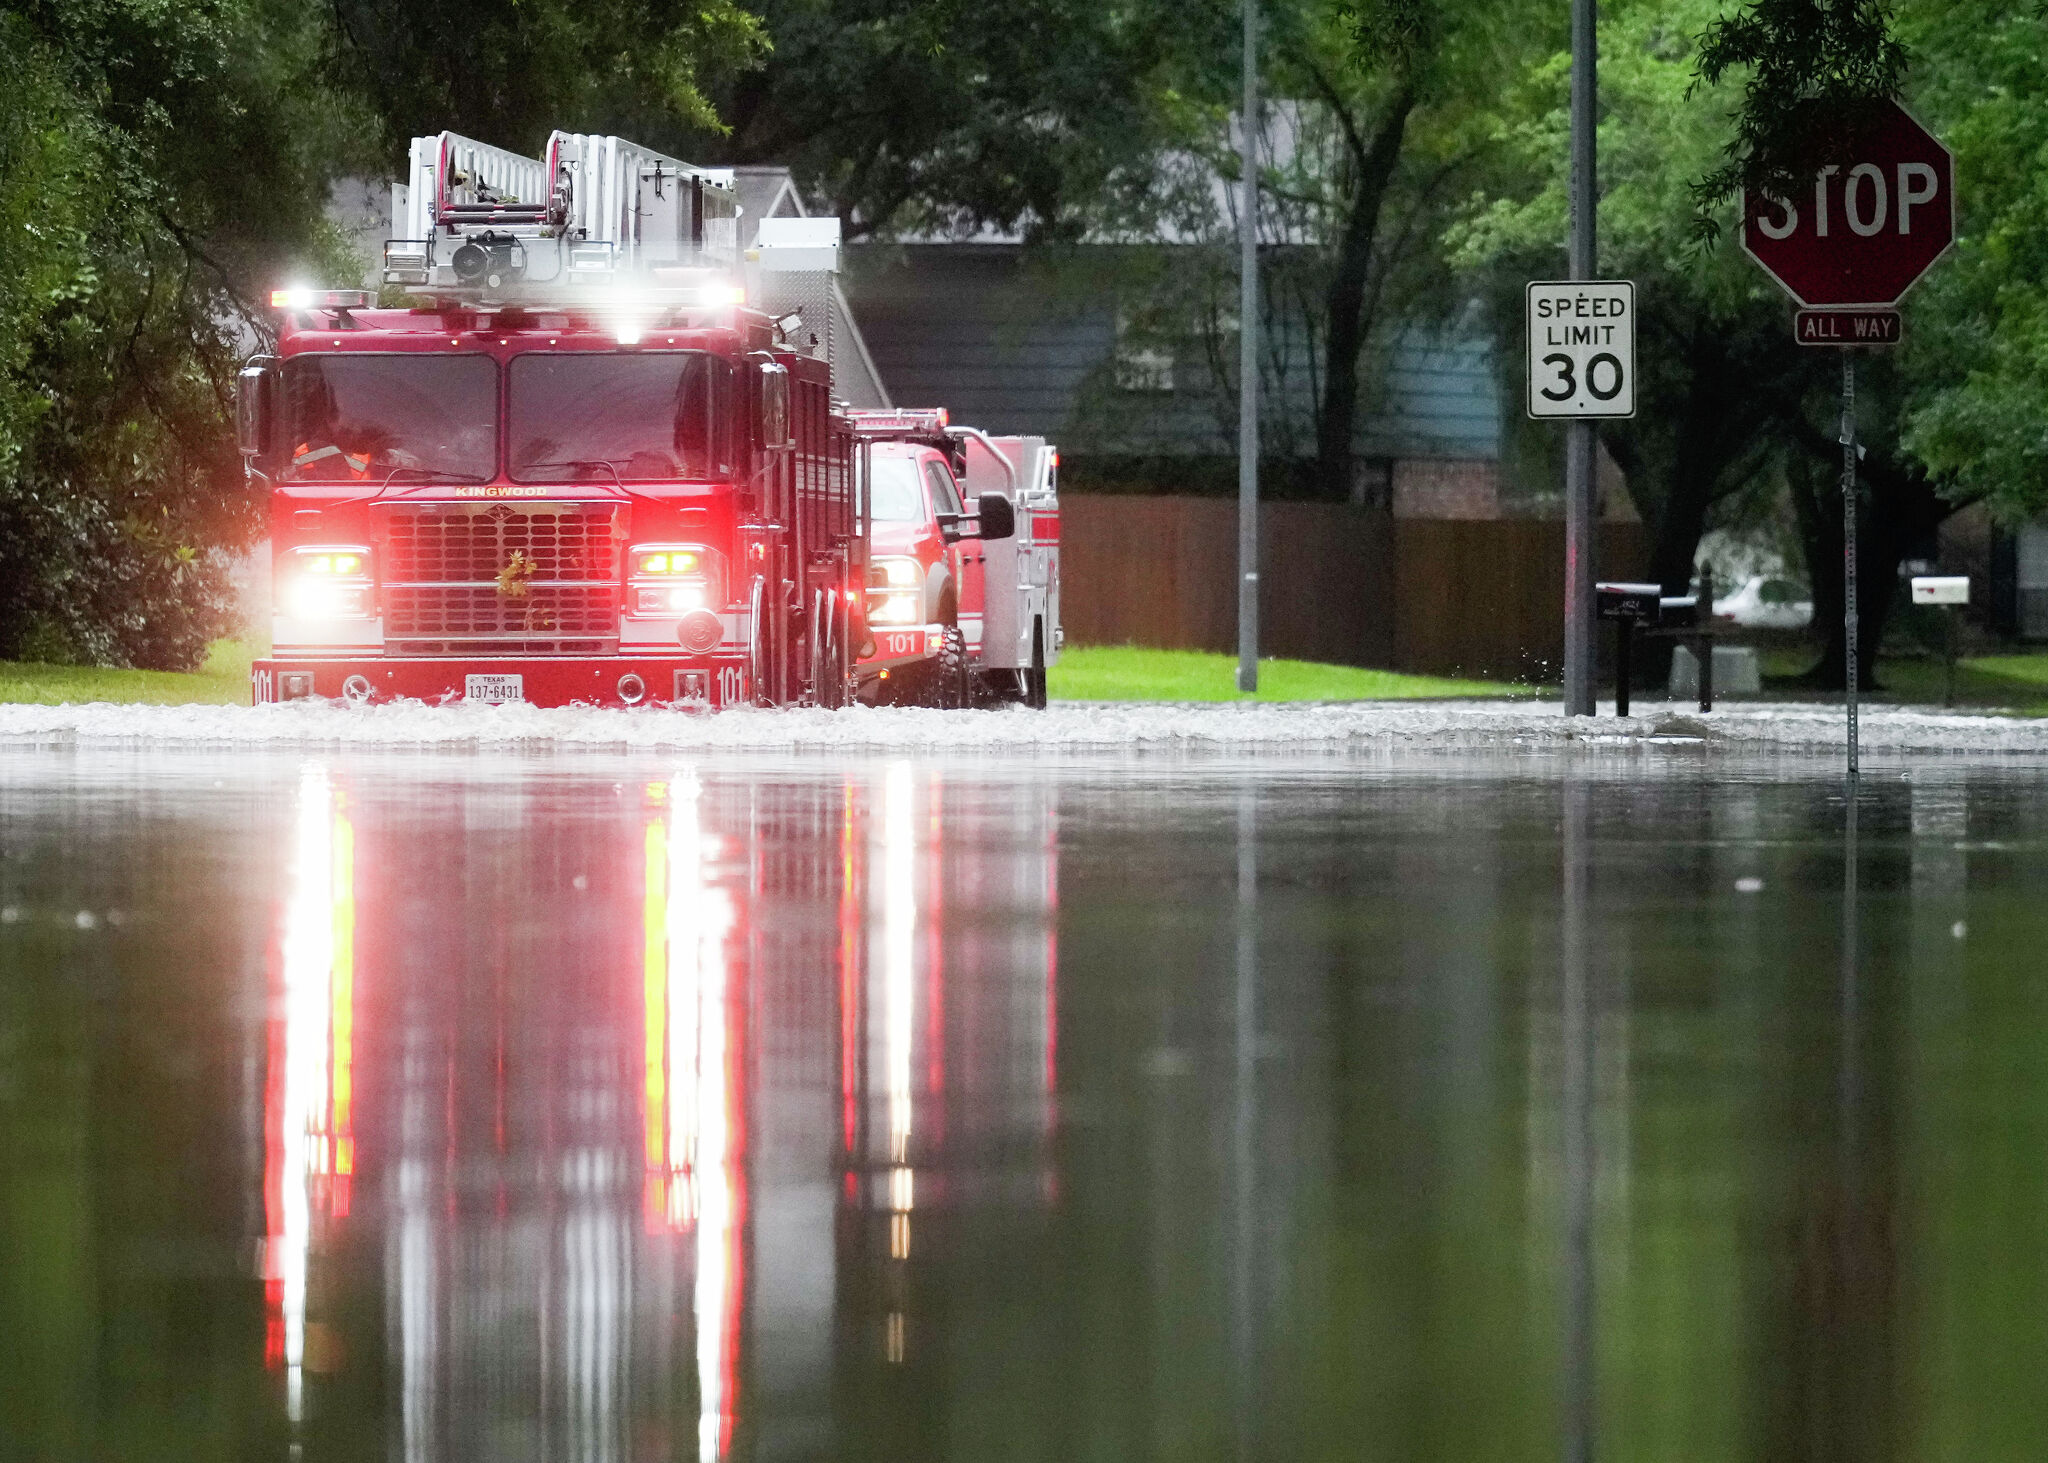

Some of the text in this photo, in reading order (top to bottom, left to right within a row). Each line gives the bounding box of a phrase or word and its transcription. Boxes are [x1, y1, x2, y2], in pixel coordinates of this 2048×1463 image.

[1757, 162, 1938, 240] STOP
[1537, 297, 1625, 318] SPEED
[1547, 325, 1615, 346] LIMIT
[1804, 317, 1893, 338] ALL WAY
[1540, 352, 1624, 402] 30
[455, 487, 547, 497] KINGWOOD
[886, 633, 916, 653] 101
[252, 669, 272, 705] 101
[717, 666, 743, 706] 101
